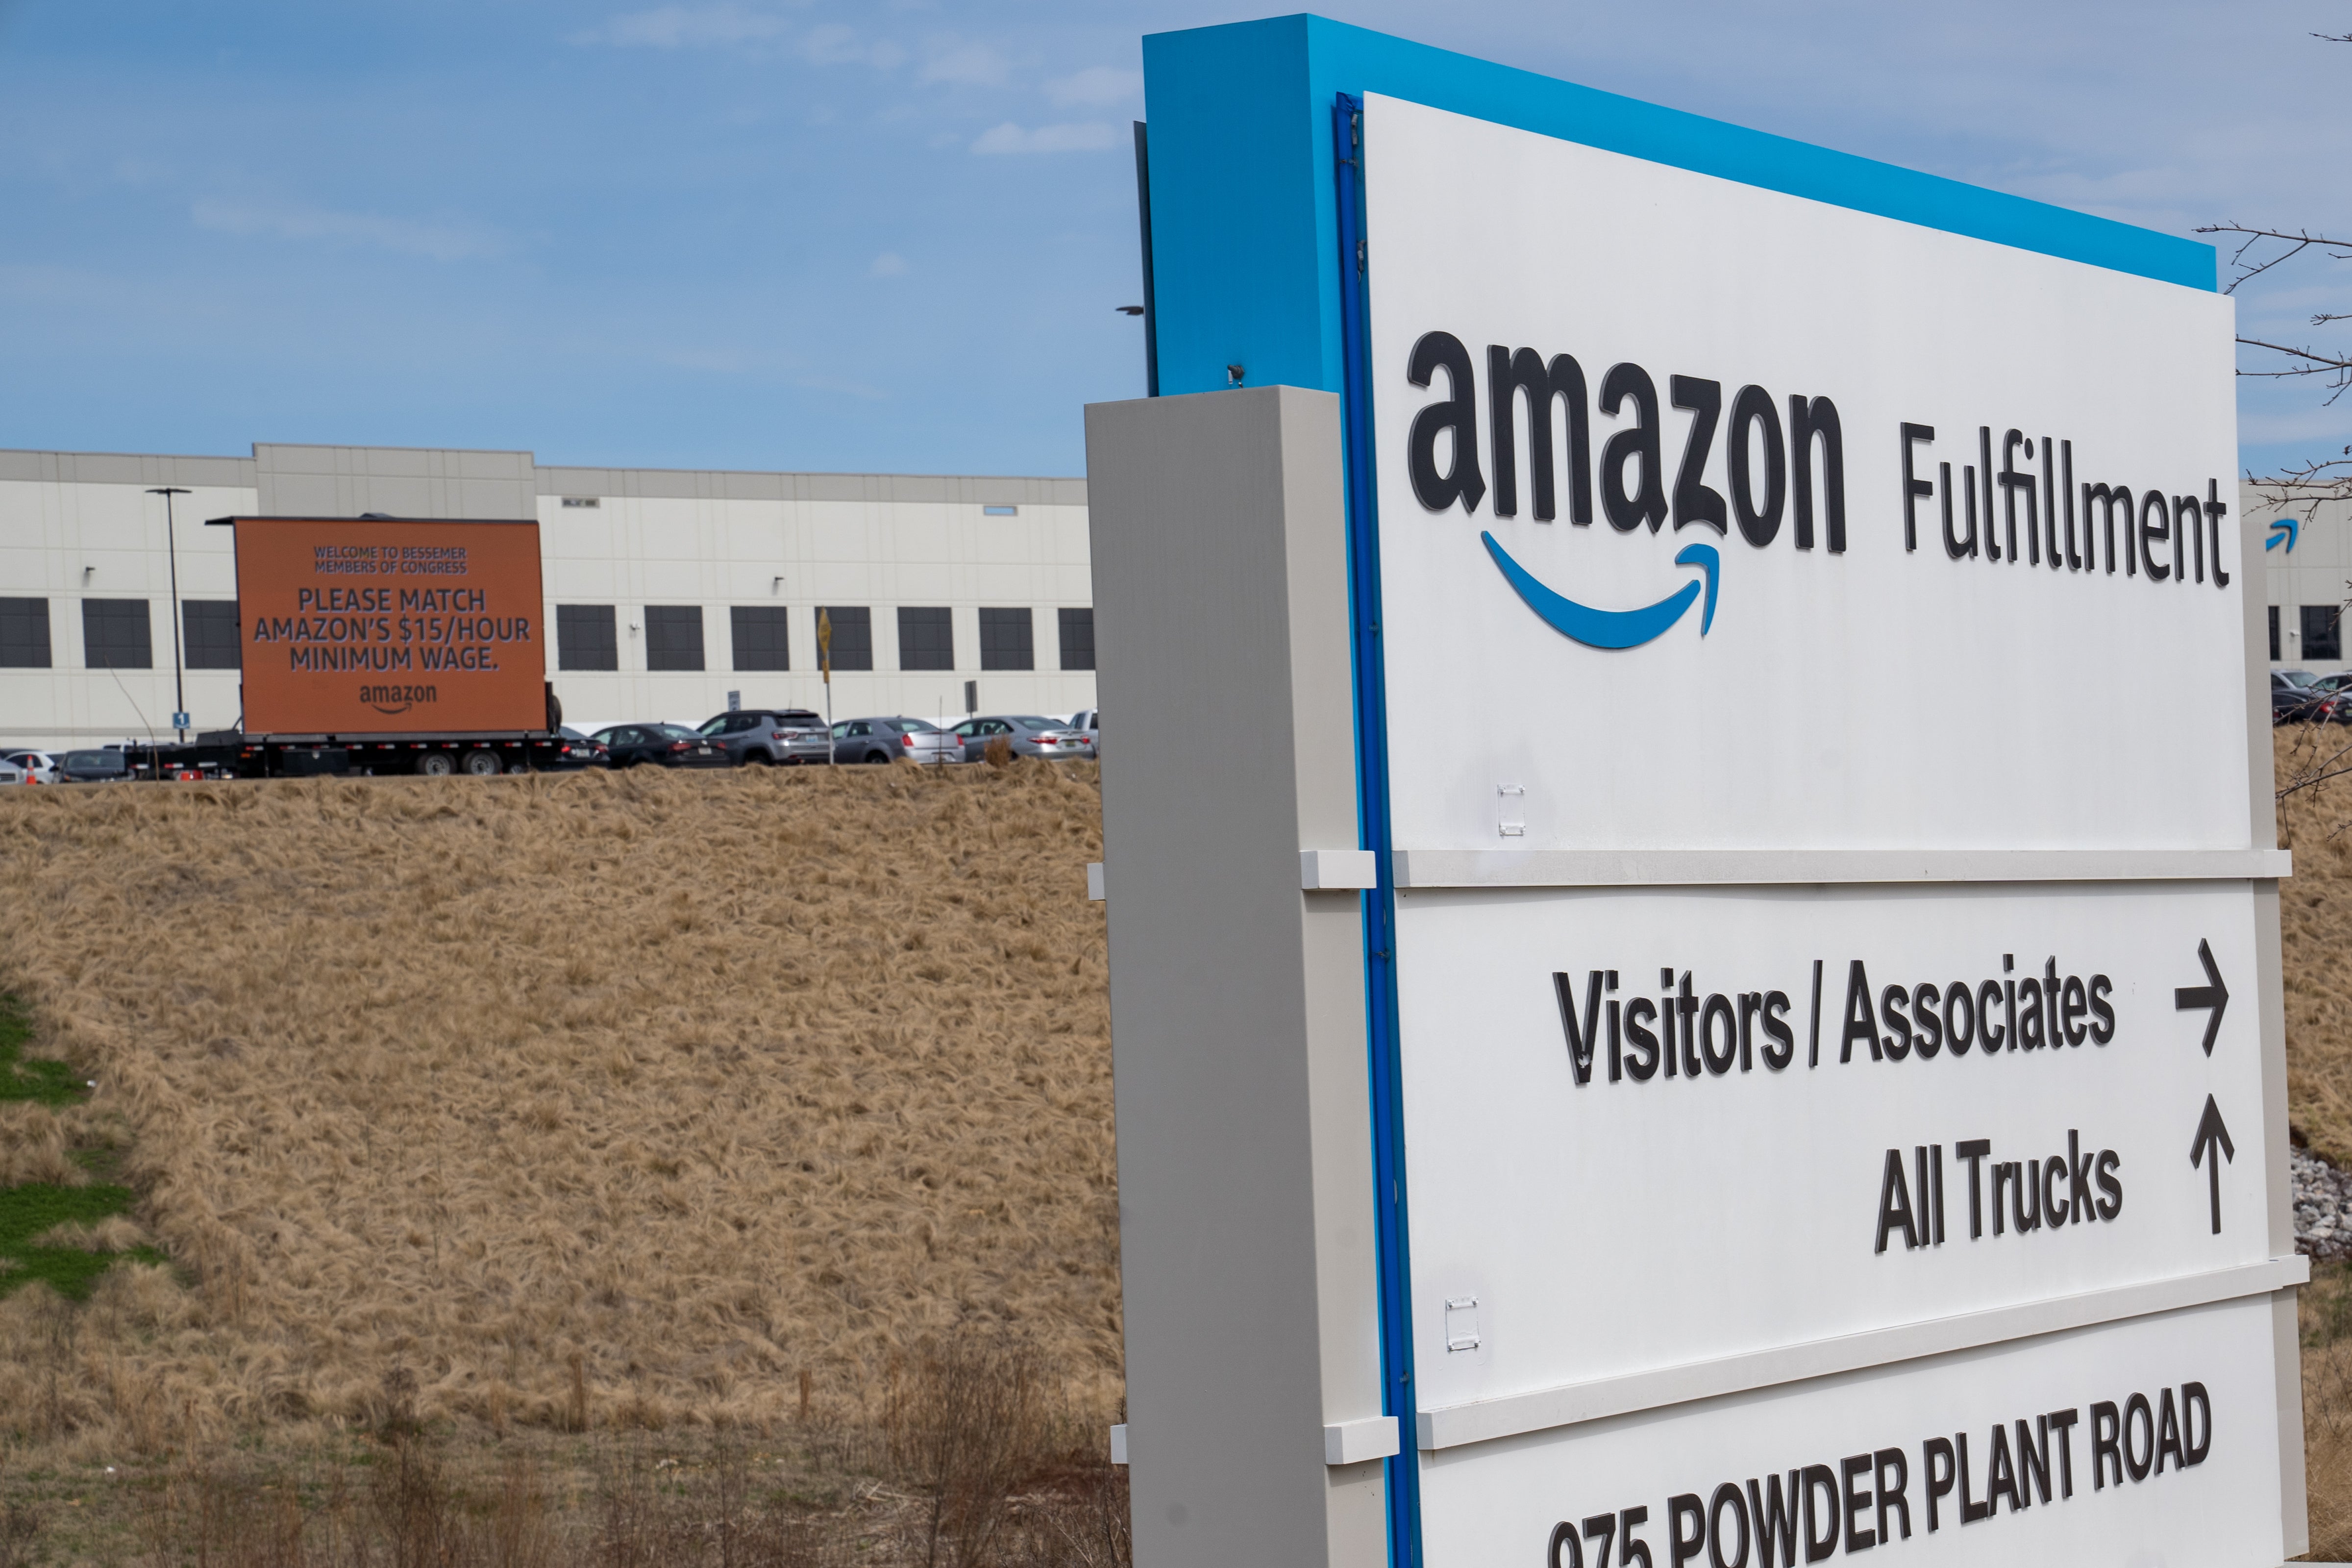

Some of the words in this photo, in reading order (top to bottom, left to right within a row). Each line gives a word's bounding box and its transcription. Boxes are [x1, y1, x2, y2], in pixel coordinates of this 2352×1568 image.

[1408, 330, 1846, 553] amazon
[1900, 422, 2229, 587] Fulfillment
[314, 547, 378, 559] WELCOME
[381, 547, 399, 559] TO
[402, 548, 467, 560] BESSEMER
[315, 561, 376, 574] MEMBERS
[380, 562, 396, 573] OF
[401, 562, 468, 574] CONGRESS
[299, 588, 392, 613] PLEASE
[399, 589, 486, 613] MATCH
[254, 617, 391, 643] AMAZON'S
[399, 614, 531, 647] $15/HOUR
[291, 647, 412, 672] MINIMUM
[420, 647, 499, 672] WAGE.
[359, 685, 437, 703] amazon
[178, 714, 184, 724] 1
[1552, 967, 1794, 1084] Visitors
[1808, 959, 1823, 1068] /
[1840, 953, 2115, 1064] Associates
[1875, 1145, 1945, 1253] All
[1956, 1129, 2123, 1239] Trucks
[1667, 1446, 1911, 1568] POWDER
[1923, 1408, 2078, 1532] PLANT
[2090, 1381, 2212, 1491] ROAD
